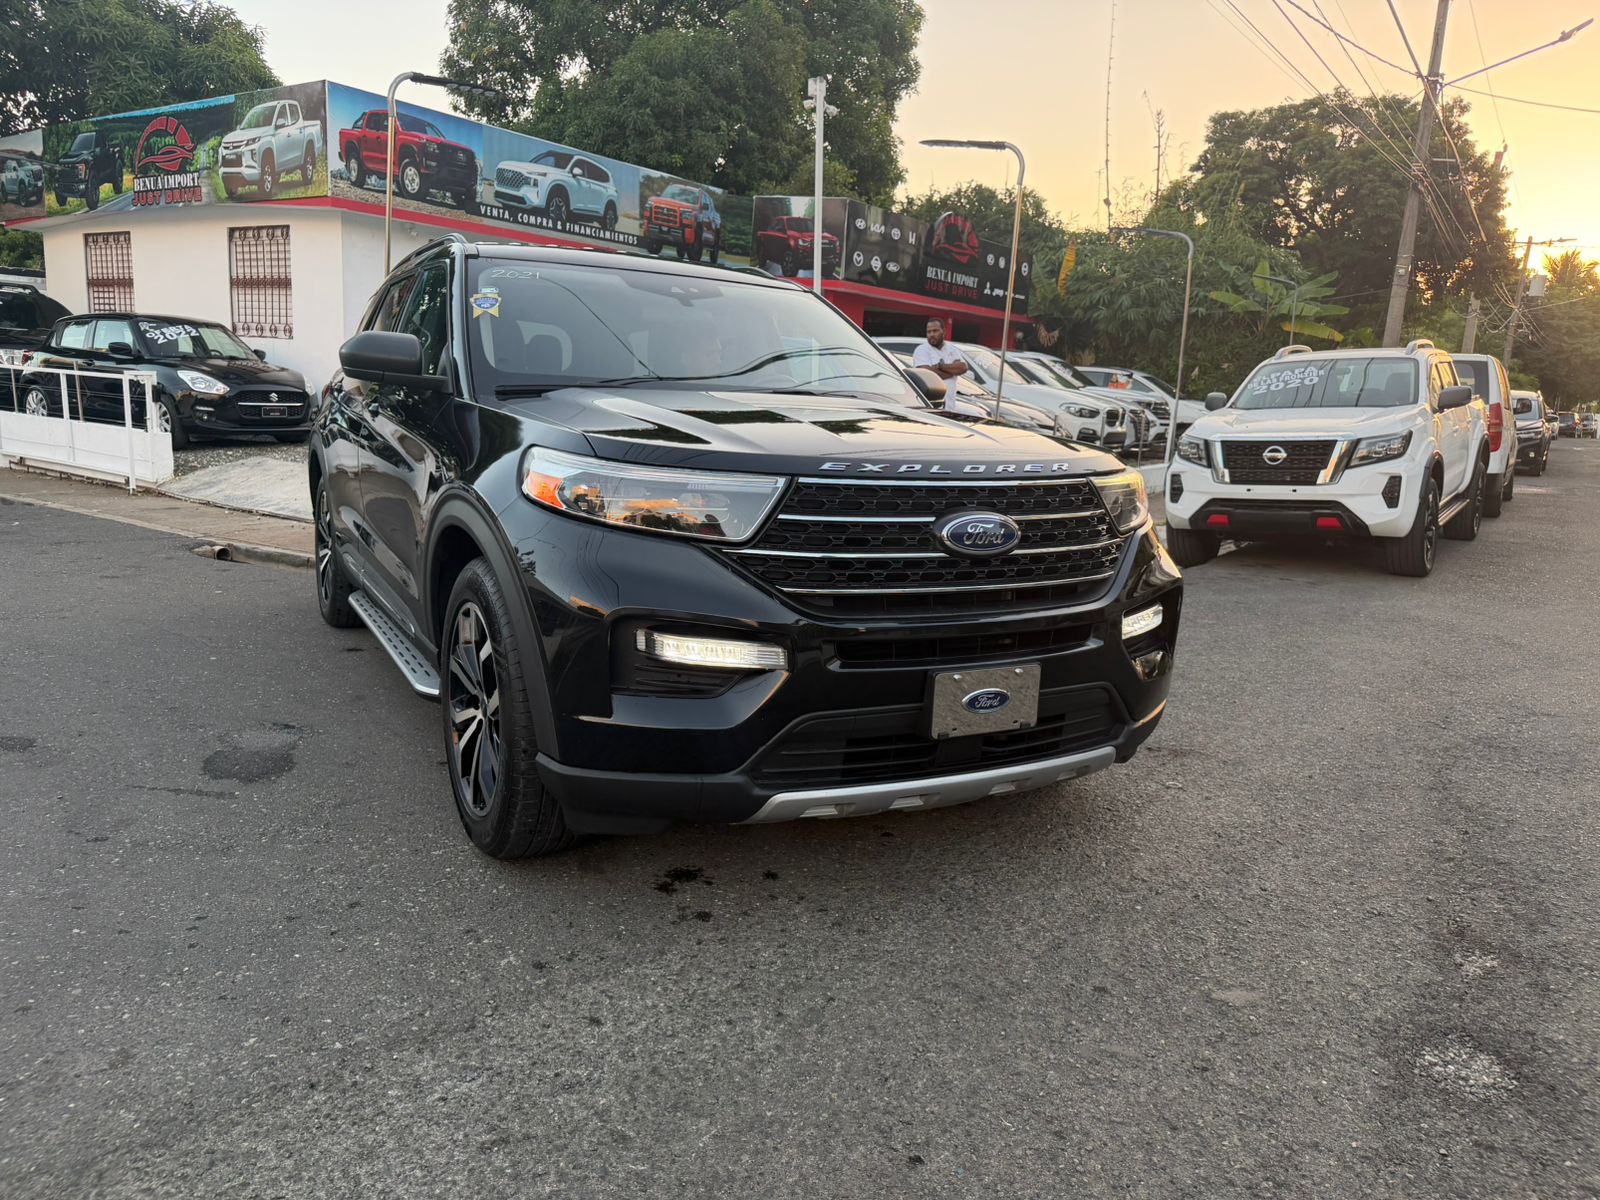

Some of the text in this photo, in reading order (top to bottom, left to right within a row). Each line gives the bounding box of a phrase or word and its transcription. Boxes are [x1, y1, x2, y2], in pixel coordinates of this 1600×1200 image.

[134, 172, 199, 191] BENUA IMPORT
[133, 186, 202, 206] JUST DRIVE
[480, 204, 638, 245] VENTA, COMPRA & FINANCIAMIENTOS
[491, 269, 539, 279] 2021
[952, 272, 979, 289] IMPORT
[926, 279, 950, 293] JUST
[952, 286, 978, 299] DRIVE
[154, 328, 200, 344] 2022
[1252, 376, 1319, 395] 2020
[818, 462, 1069, 474] EXPLORER
[963, 522, 1005, 545] Ford
[975, 694, 1001, 708] Ford
